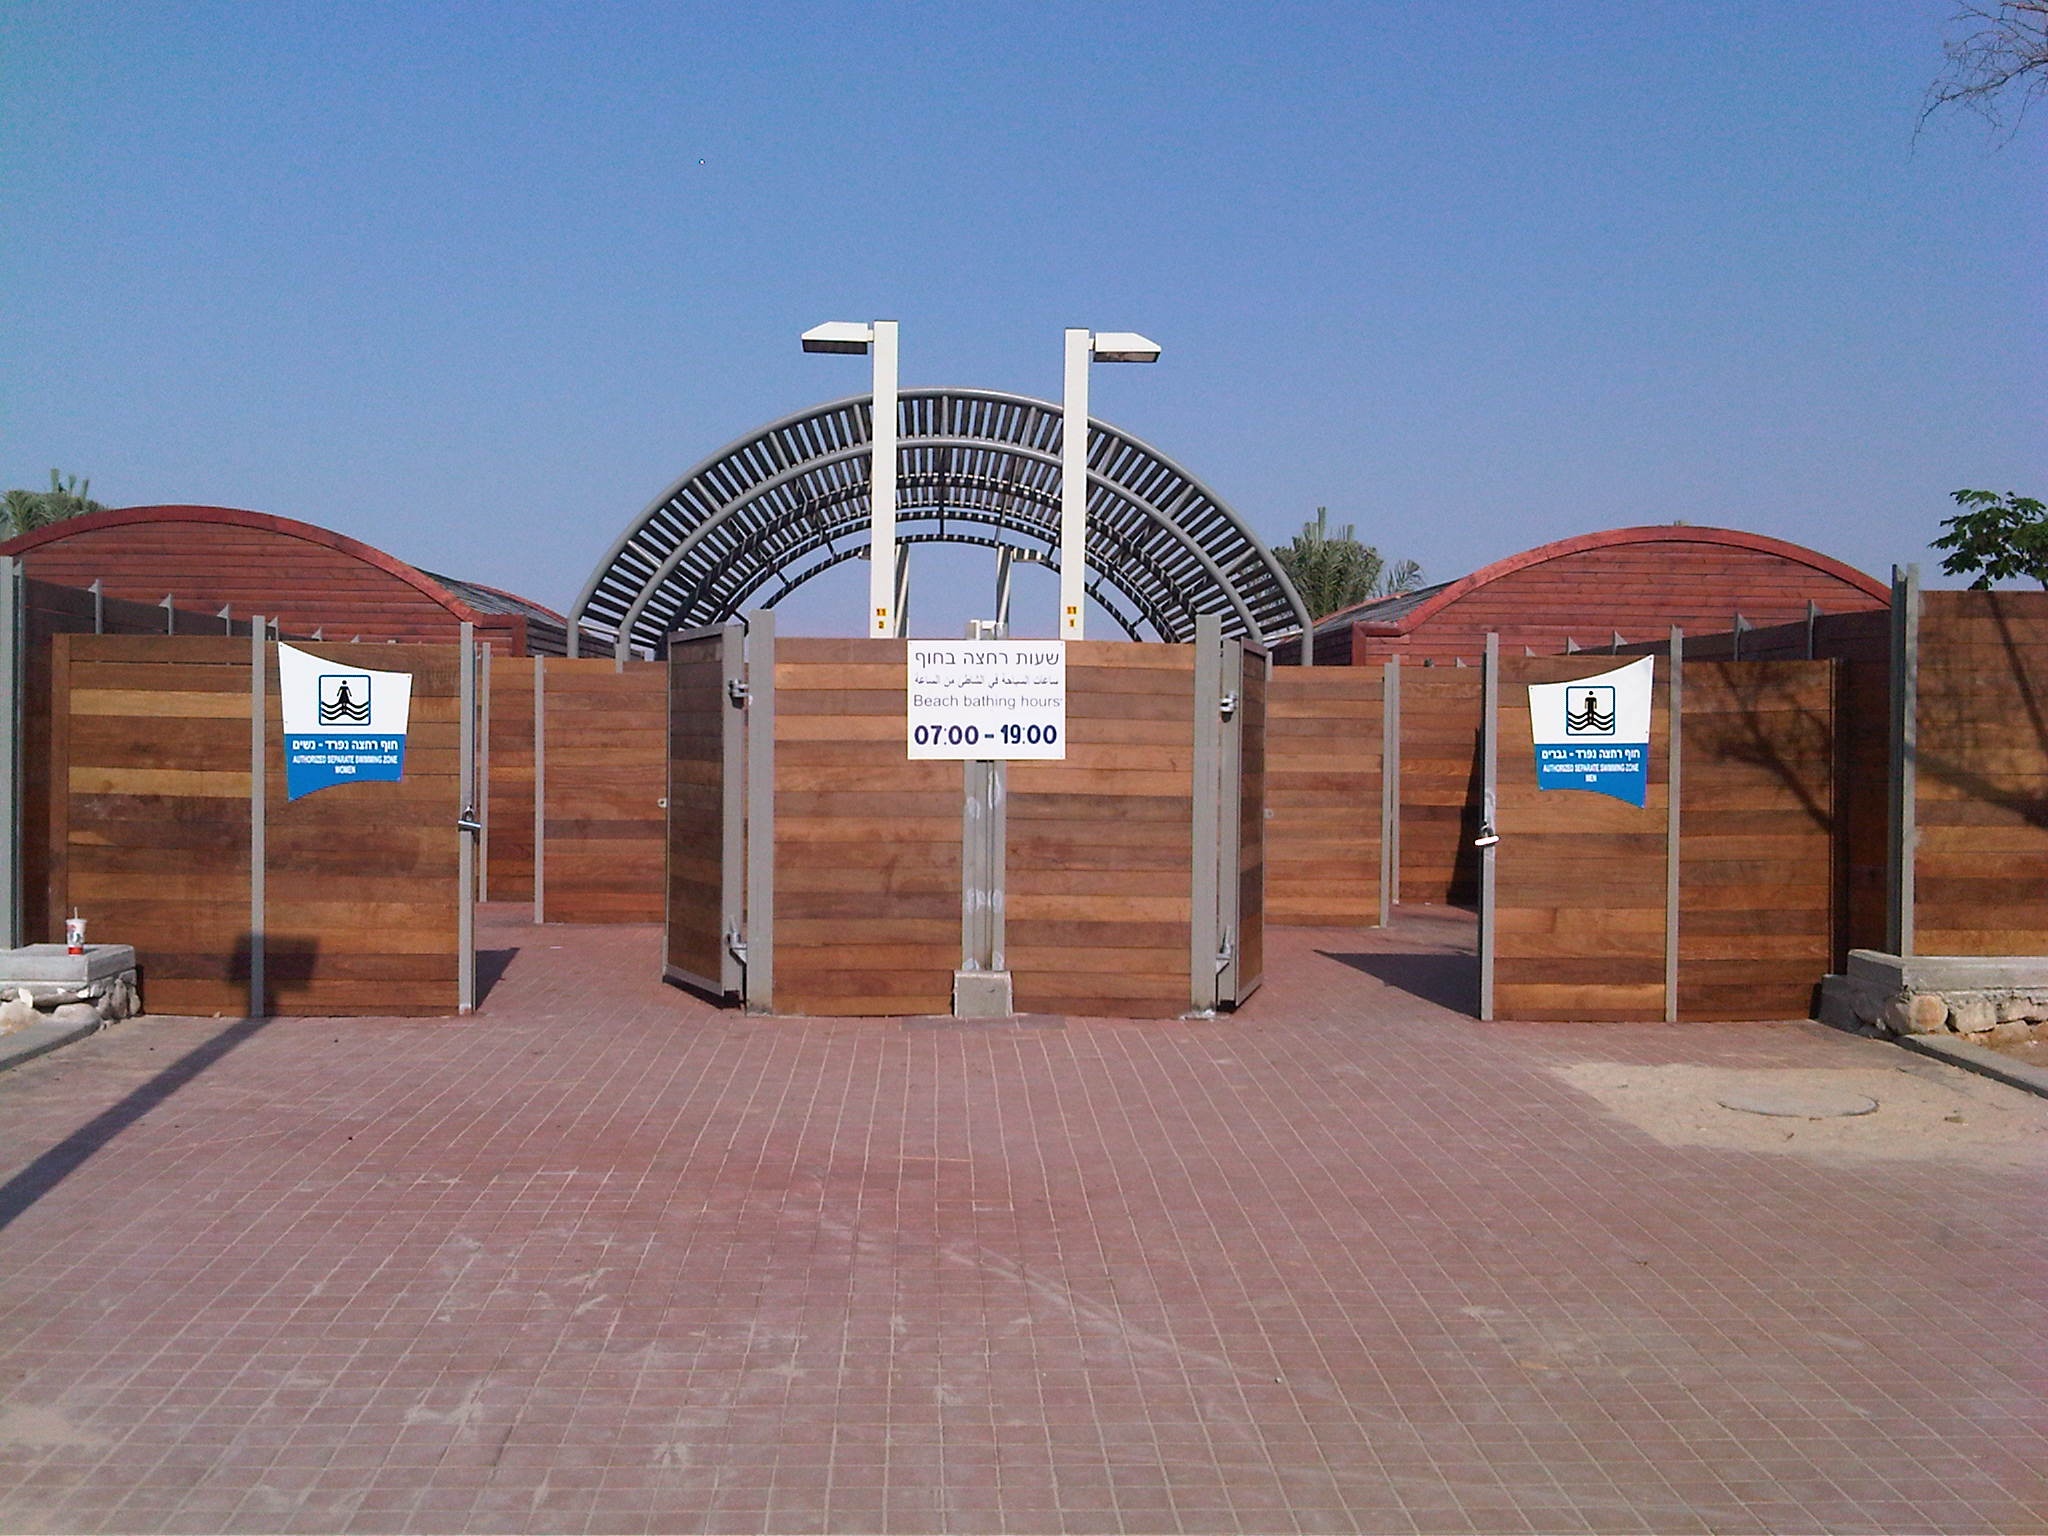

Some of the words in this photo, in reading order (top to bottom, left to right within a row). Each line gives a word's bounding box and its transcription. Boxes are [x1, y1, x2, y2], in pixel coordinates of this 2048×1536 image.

[915, 652, 956, 668] בחוף
[963, 652, 1008, 665] רחצה
[1016, 652, 1059, 665] שעות
[914, 694, 959, 707] Beach
[964, 695, 1016, 710] bathing
[914, 725, 980, 745] 07:00
[1000, 724, 1057, 744] 19:00
[292, 740, 316, 750] נשים
[324, 740, 350, 750] נפרד
[352, 740, 379, 750] רחצה
[380, 740, 398, 752] חוף
[1541, 749, 1567, 759] גברים
[1575, 749, 1597, 759] נפרד
[1599, 749, 1623, 759] רחצה
[1624, 749, 1641, 761] חוף
